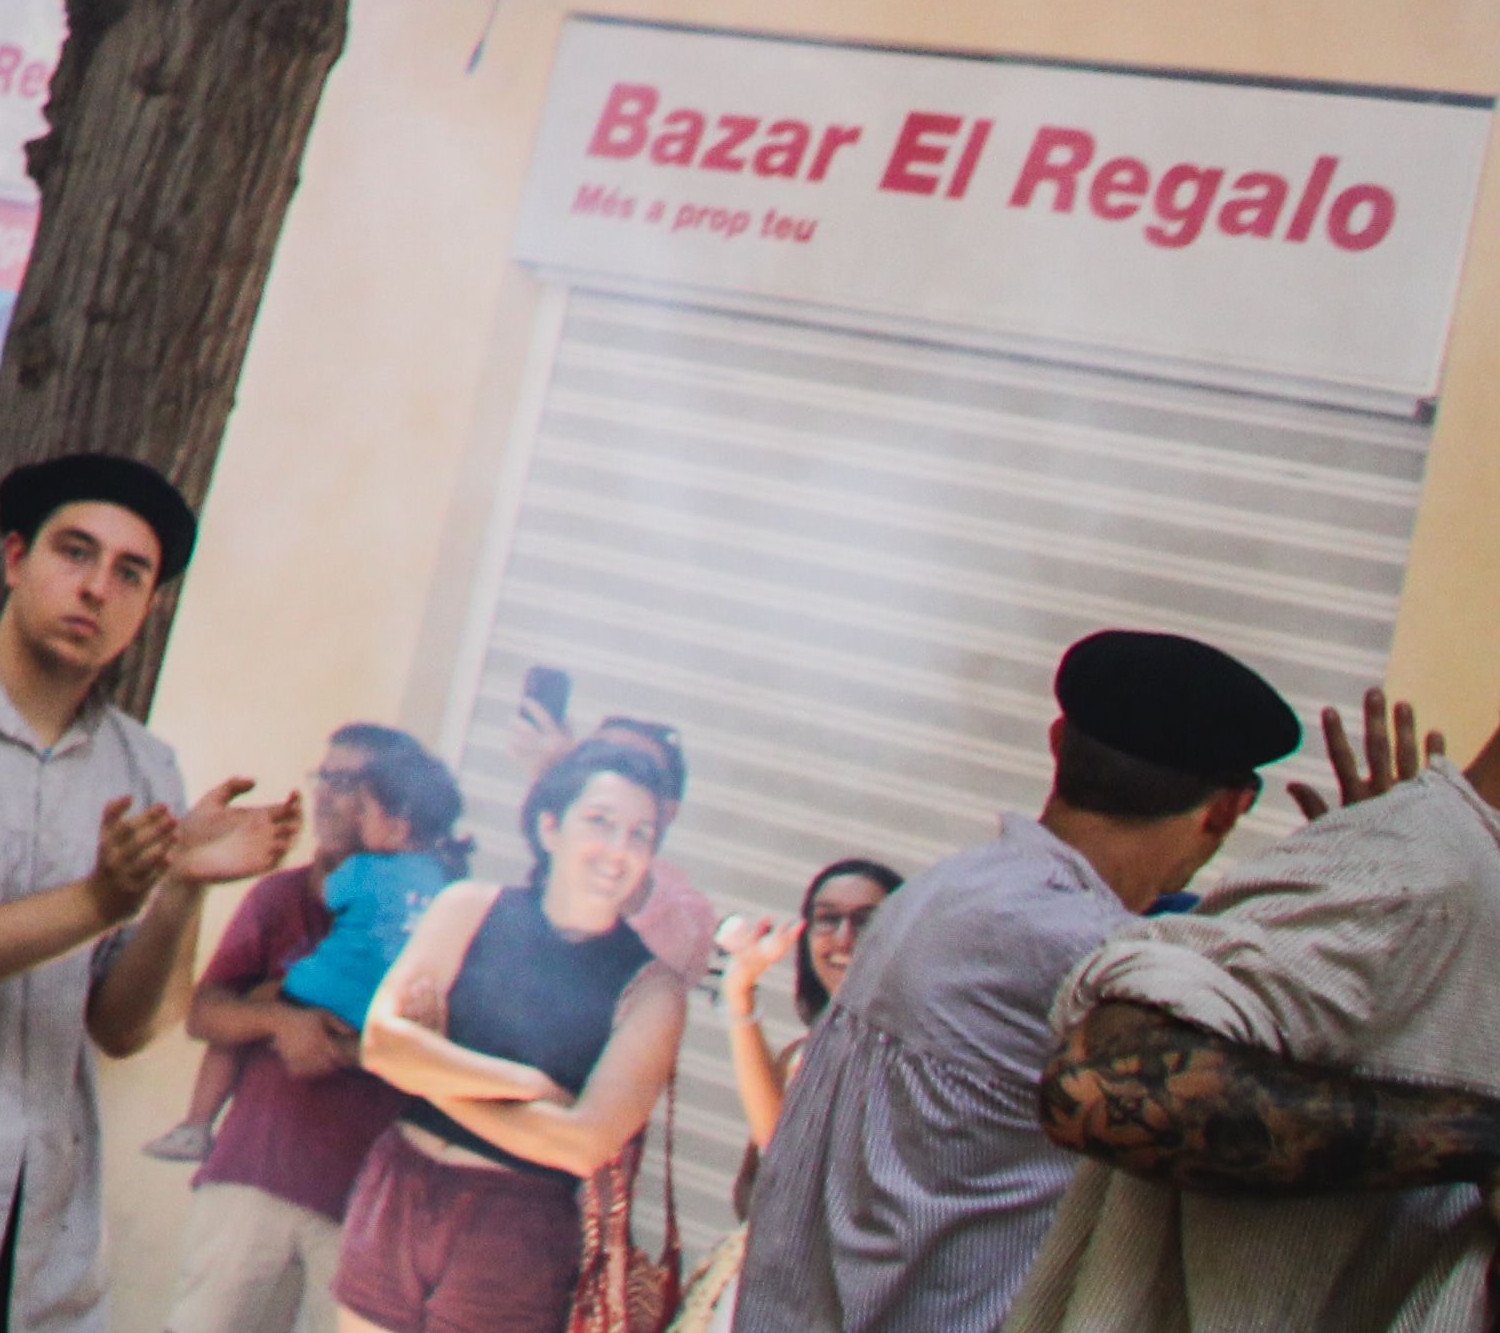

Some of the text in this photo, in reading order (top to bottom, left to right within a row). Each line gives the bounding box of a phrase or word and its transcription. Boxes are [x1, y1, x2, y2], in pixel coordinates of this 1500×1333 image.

[586, 82, 1396, 252] Bazar El Regalo
[646, 198, 667, 224] a
[670, 201, 752, 240] prop
[759, 207, 820, 245] teu
